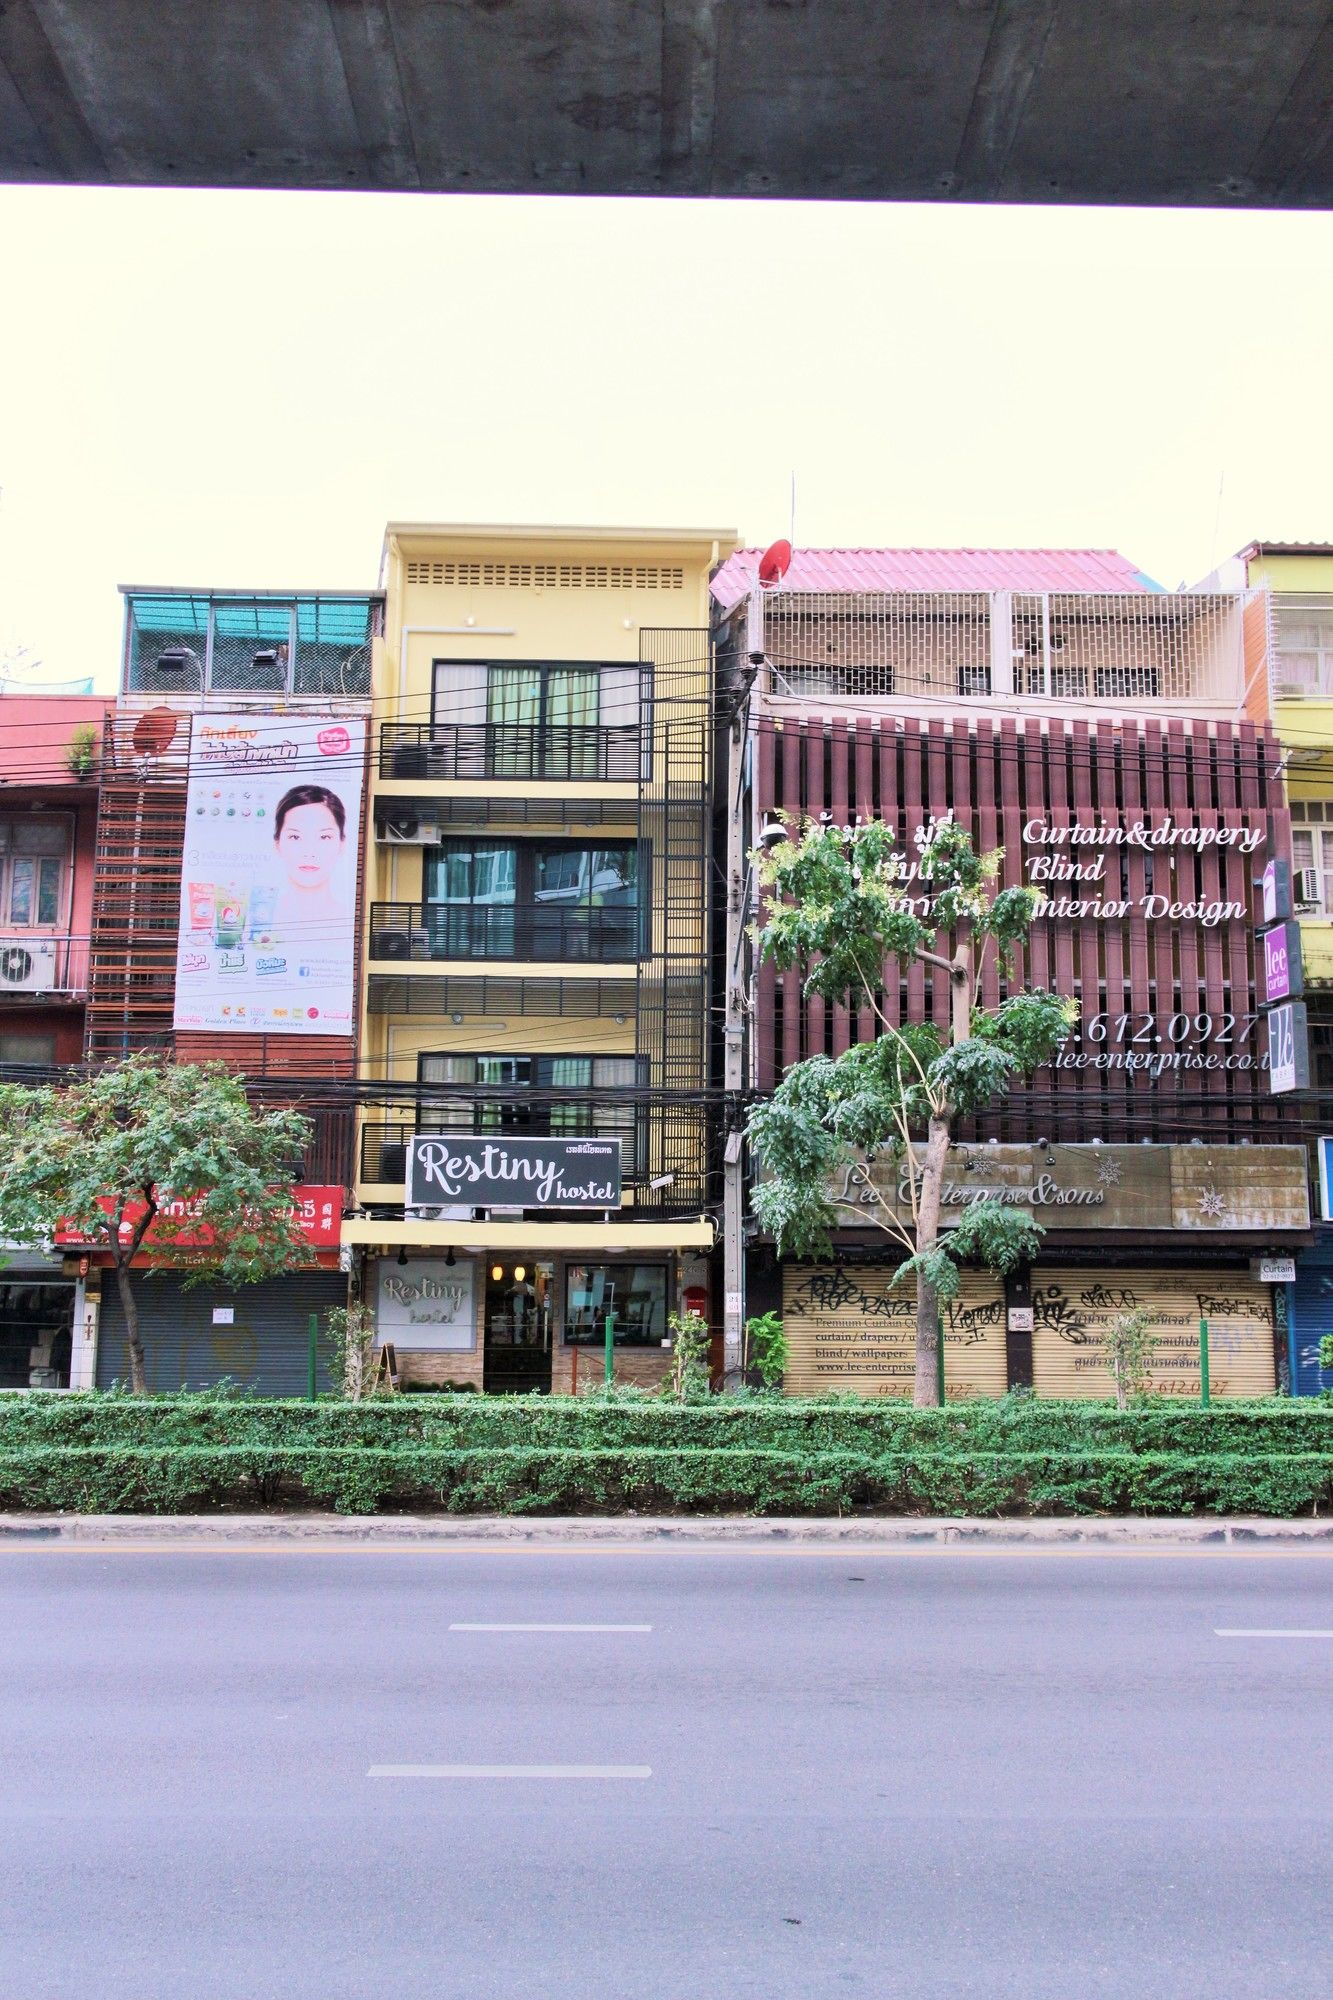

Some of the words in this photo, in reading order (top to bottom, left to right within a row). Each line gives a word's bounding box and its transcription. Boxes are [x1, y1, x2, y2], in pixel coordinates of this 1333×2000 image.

[1024, 853, 1107, 881] Blind
[1139, 893, 1248, 927] Design
[1266, 941, 1287, 977] lee
[1268, 974, 1288, 991] curtain
[417, 1142, 565, 1202] Restiny
[556, 1180, 615, 1200] hostel
[1263, 1264, 1293, 1274] Curtain
[384, 1275, 468, 1312] Restiny
[815, 1317, 862, 1328] Premium
[864, 1317, 902, 1328] Curtain
[815, 1332, 852, 1342] curtain
[860, 1332, 898, 1344] drapery
[852, 1348, 908, 1360] wallpapers
